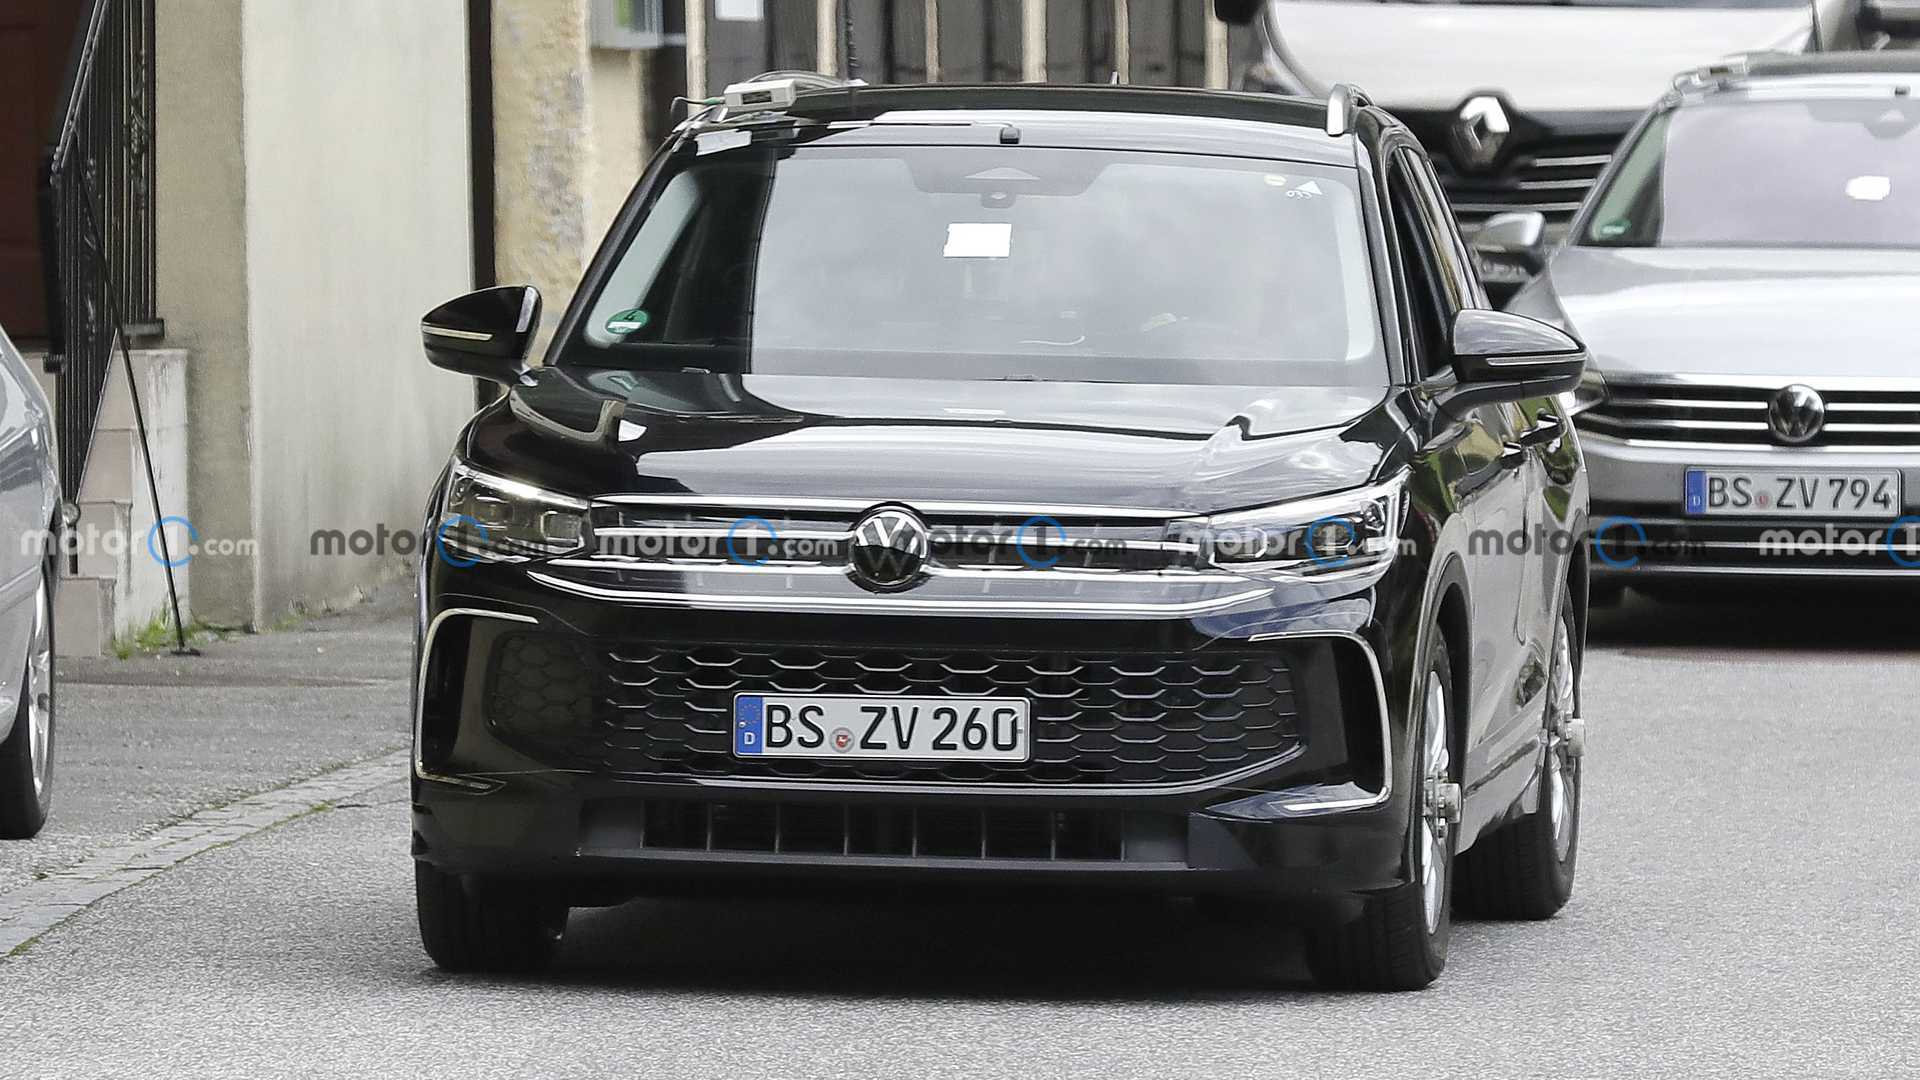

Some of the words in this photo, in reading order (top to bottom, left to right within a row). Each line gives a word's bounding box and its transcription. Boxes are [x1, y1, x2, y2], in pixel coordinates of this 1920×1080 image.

[1708, 476, 1752, 508] BS
[1775, 477, 1819, 509] ZV
[1828, 478, 1892, 510] 794
[743, 731, 756, 745] D
[766, 704, 825, 748] BS
[859, 705, 919, 750] ZV
[931, 706, 1019, 751] 260
